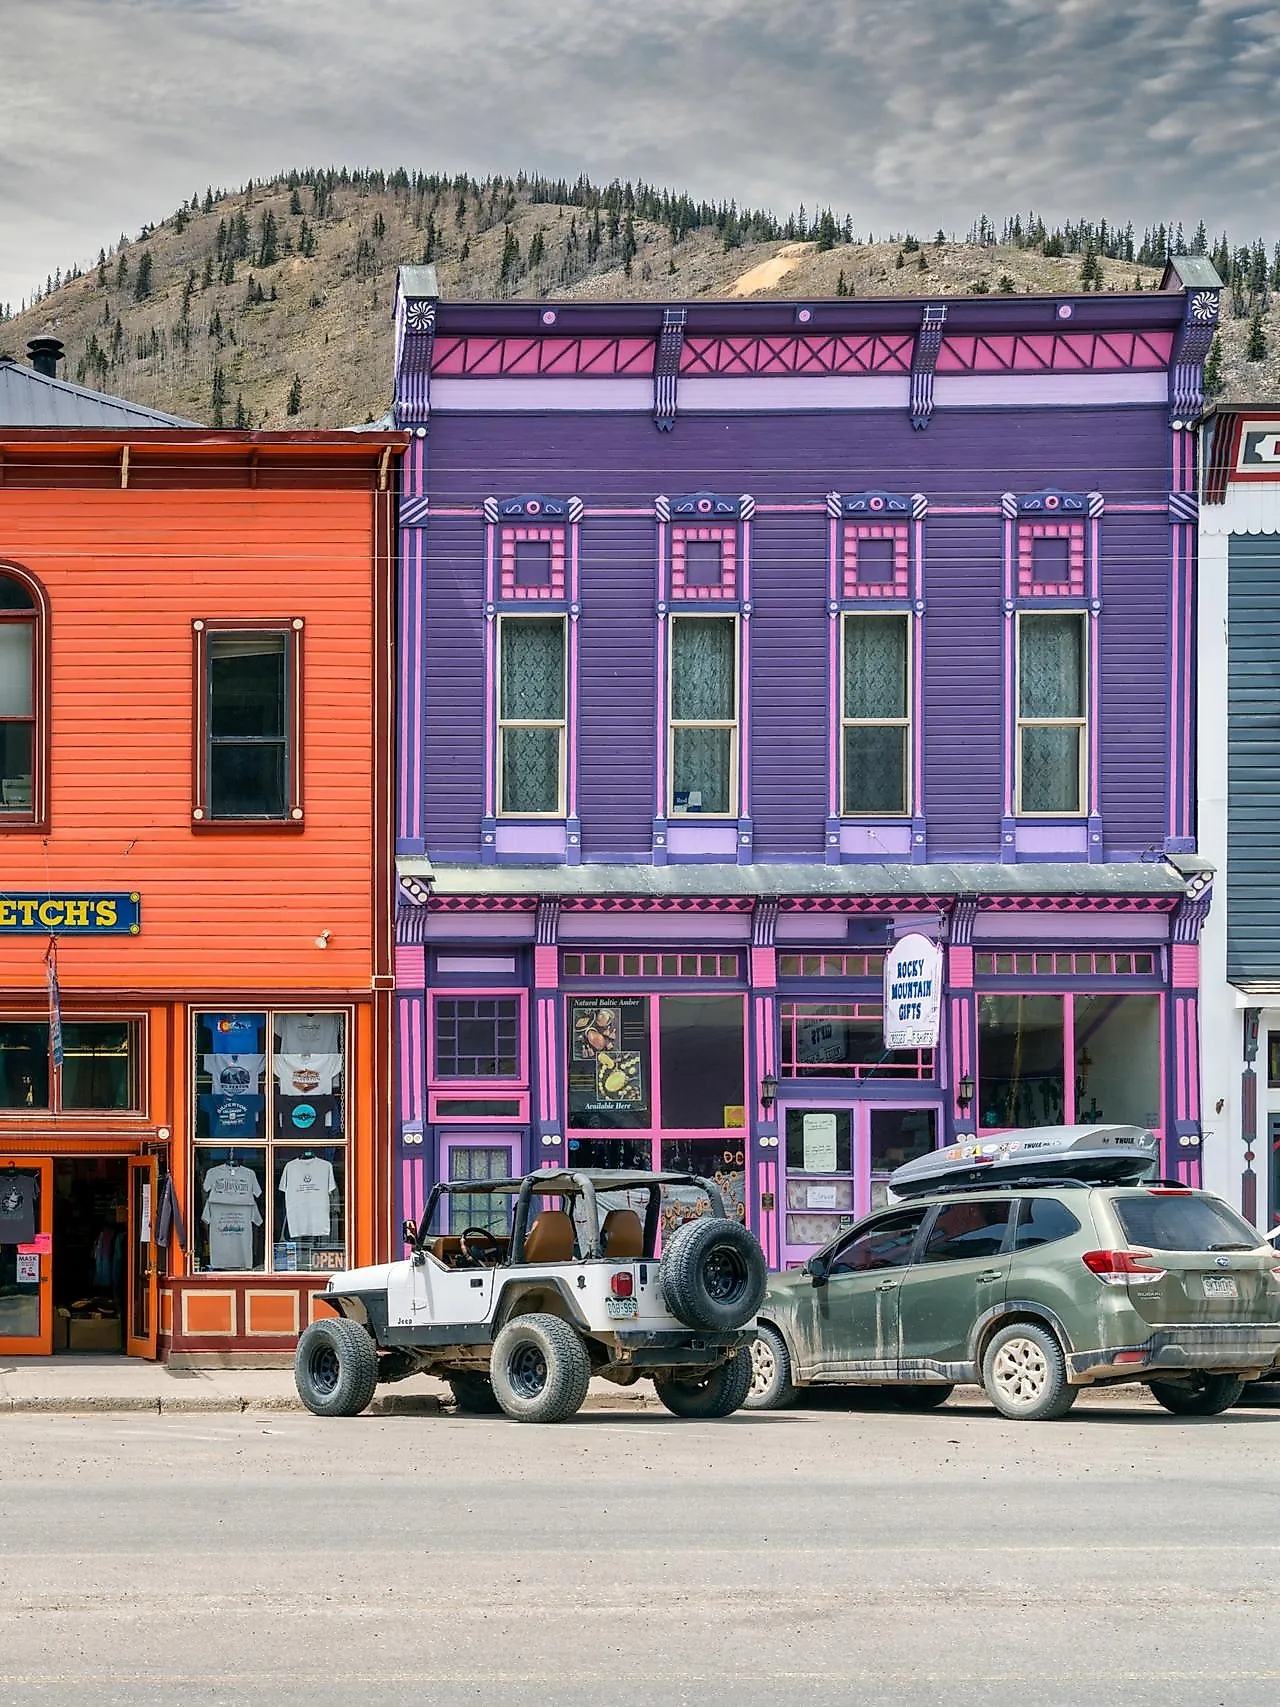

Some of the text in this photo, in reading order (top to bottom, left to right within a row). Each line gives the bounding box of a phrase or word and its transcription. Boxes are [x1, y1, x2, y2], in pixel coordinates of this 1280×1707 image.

[896, 959, 925, 979] ROCKY
[891, 979, 933, 1000] MOUNTAIN
[898, 1002, 922, 1021] GIFTS
[585, 1101, 632, 1110] Available Here
[1115, 1137, 1135, 1145] THULE
[312, 1252, 344, 1269] OPEN
[397, 1317, 413, 1325] Jeep
